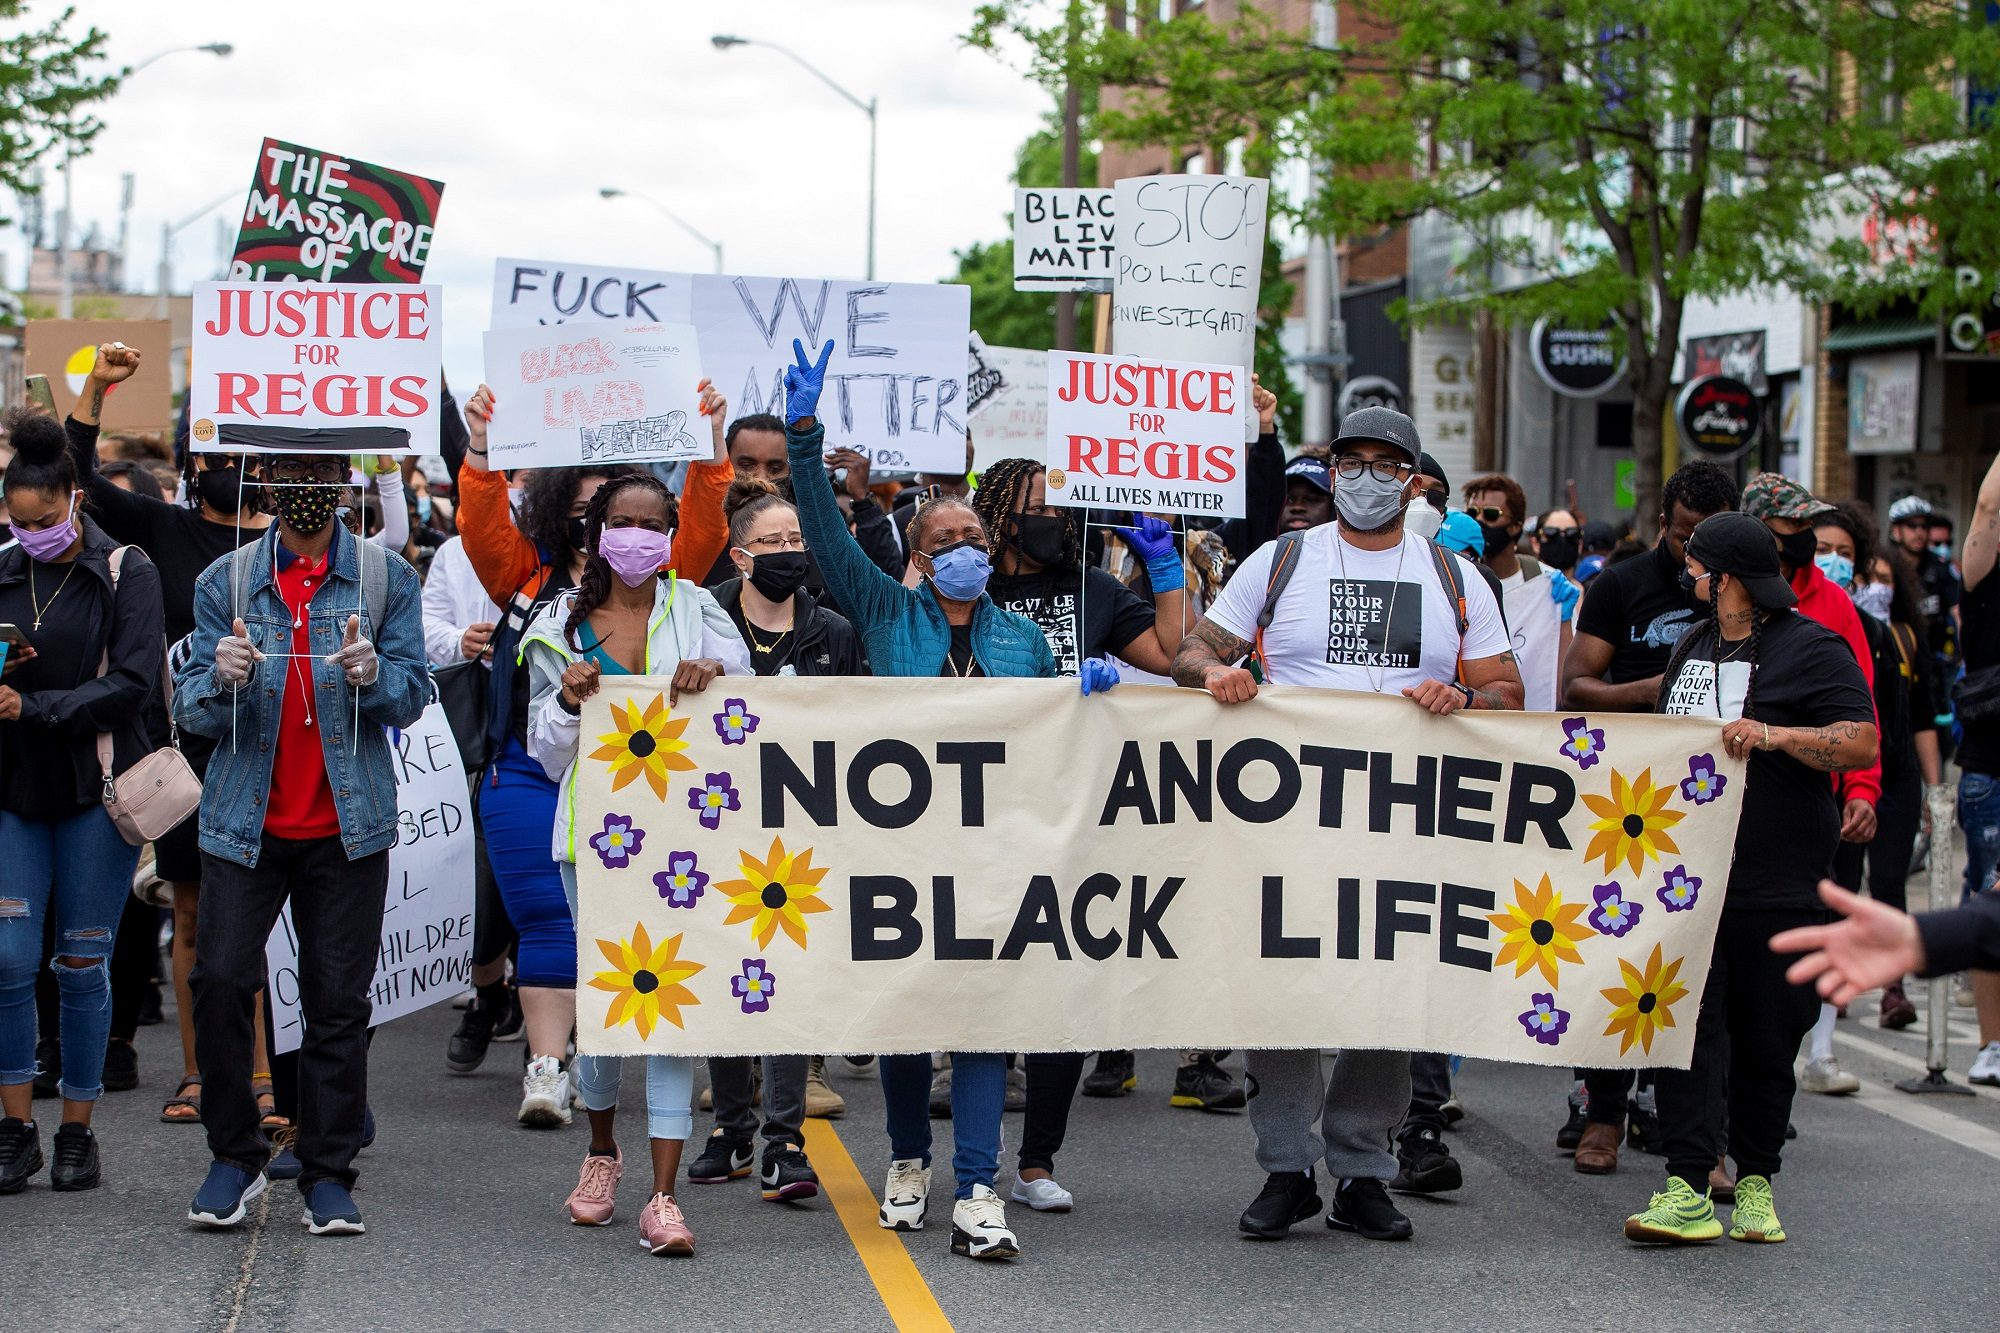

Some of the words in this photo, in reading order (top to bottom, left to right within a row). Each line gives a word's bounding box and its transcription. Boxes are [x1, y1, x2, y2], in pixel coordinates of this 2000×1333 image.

[266, 147, 350, 203] THE
[246, 189, 434, 266] MASSACRE
[1025, 193, 1115, 222] BLAC
[1134, 181, 1261, 247] STOP
[1054, 223, 1115, 243] LIV
[299, 236, 353, 283] OF
[1028, 245, 1115, 270] MATT
[1119, 255, 1248, 289] POLICE
[205, 286, 430, 341] JUSTICE
[510, 267, 668, 323] FUCK
[732, 275, 898, 359] WE
[292, 344, 340, 367] FOR
[520, 336, 620, 384] BLACK
[213, 371, 429, 420] REGIS
[543, 380, 647, 430] LIVES
[736, 366, 968, 437] MTTER
[1058, 359, 1236, 416] JUSTICE
[580, 410, 698, 460] MATTER
[1128, 412, 1166, 435] FOR
[1065, 434, 1237, 484] REGIS
[1070, 484, 1100, 502] ALL
[1105, 486, 1152, 506] LIVES
[1157, 490, 1224, 512] MATTER
[1331, 583, 1367, 595] GET
[1332, 595, 1383, 610] YOUR
[1330, 622, 1367, 636] OFF
[1332, 608, 1381, 623] KNEE
[1328, 649, 1409, 668] NECKS!!!
[1329, 636, 1369, 651] OUR
[1676, 677, 1713, 691] YOUR
[1681, 664, 1710, 676] GET
[1670, 691, 1707, 706] KNEE
[396, 733, 453, 787] RE
[759, 738, 1006, 829] NOT
[1099, 737, 1576, 850] ANOTHER
[390, 801, 463, 848] SED
[378, 914, 472, 972] HILDRE
[849, 872, 1187, 961] BLACK
[1260, 875, 1496, 973] LIFE
